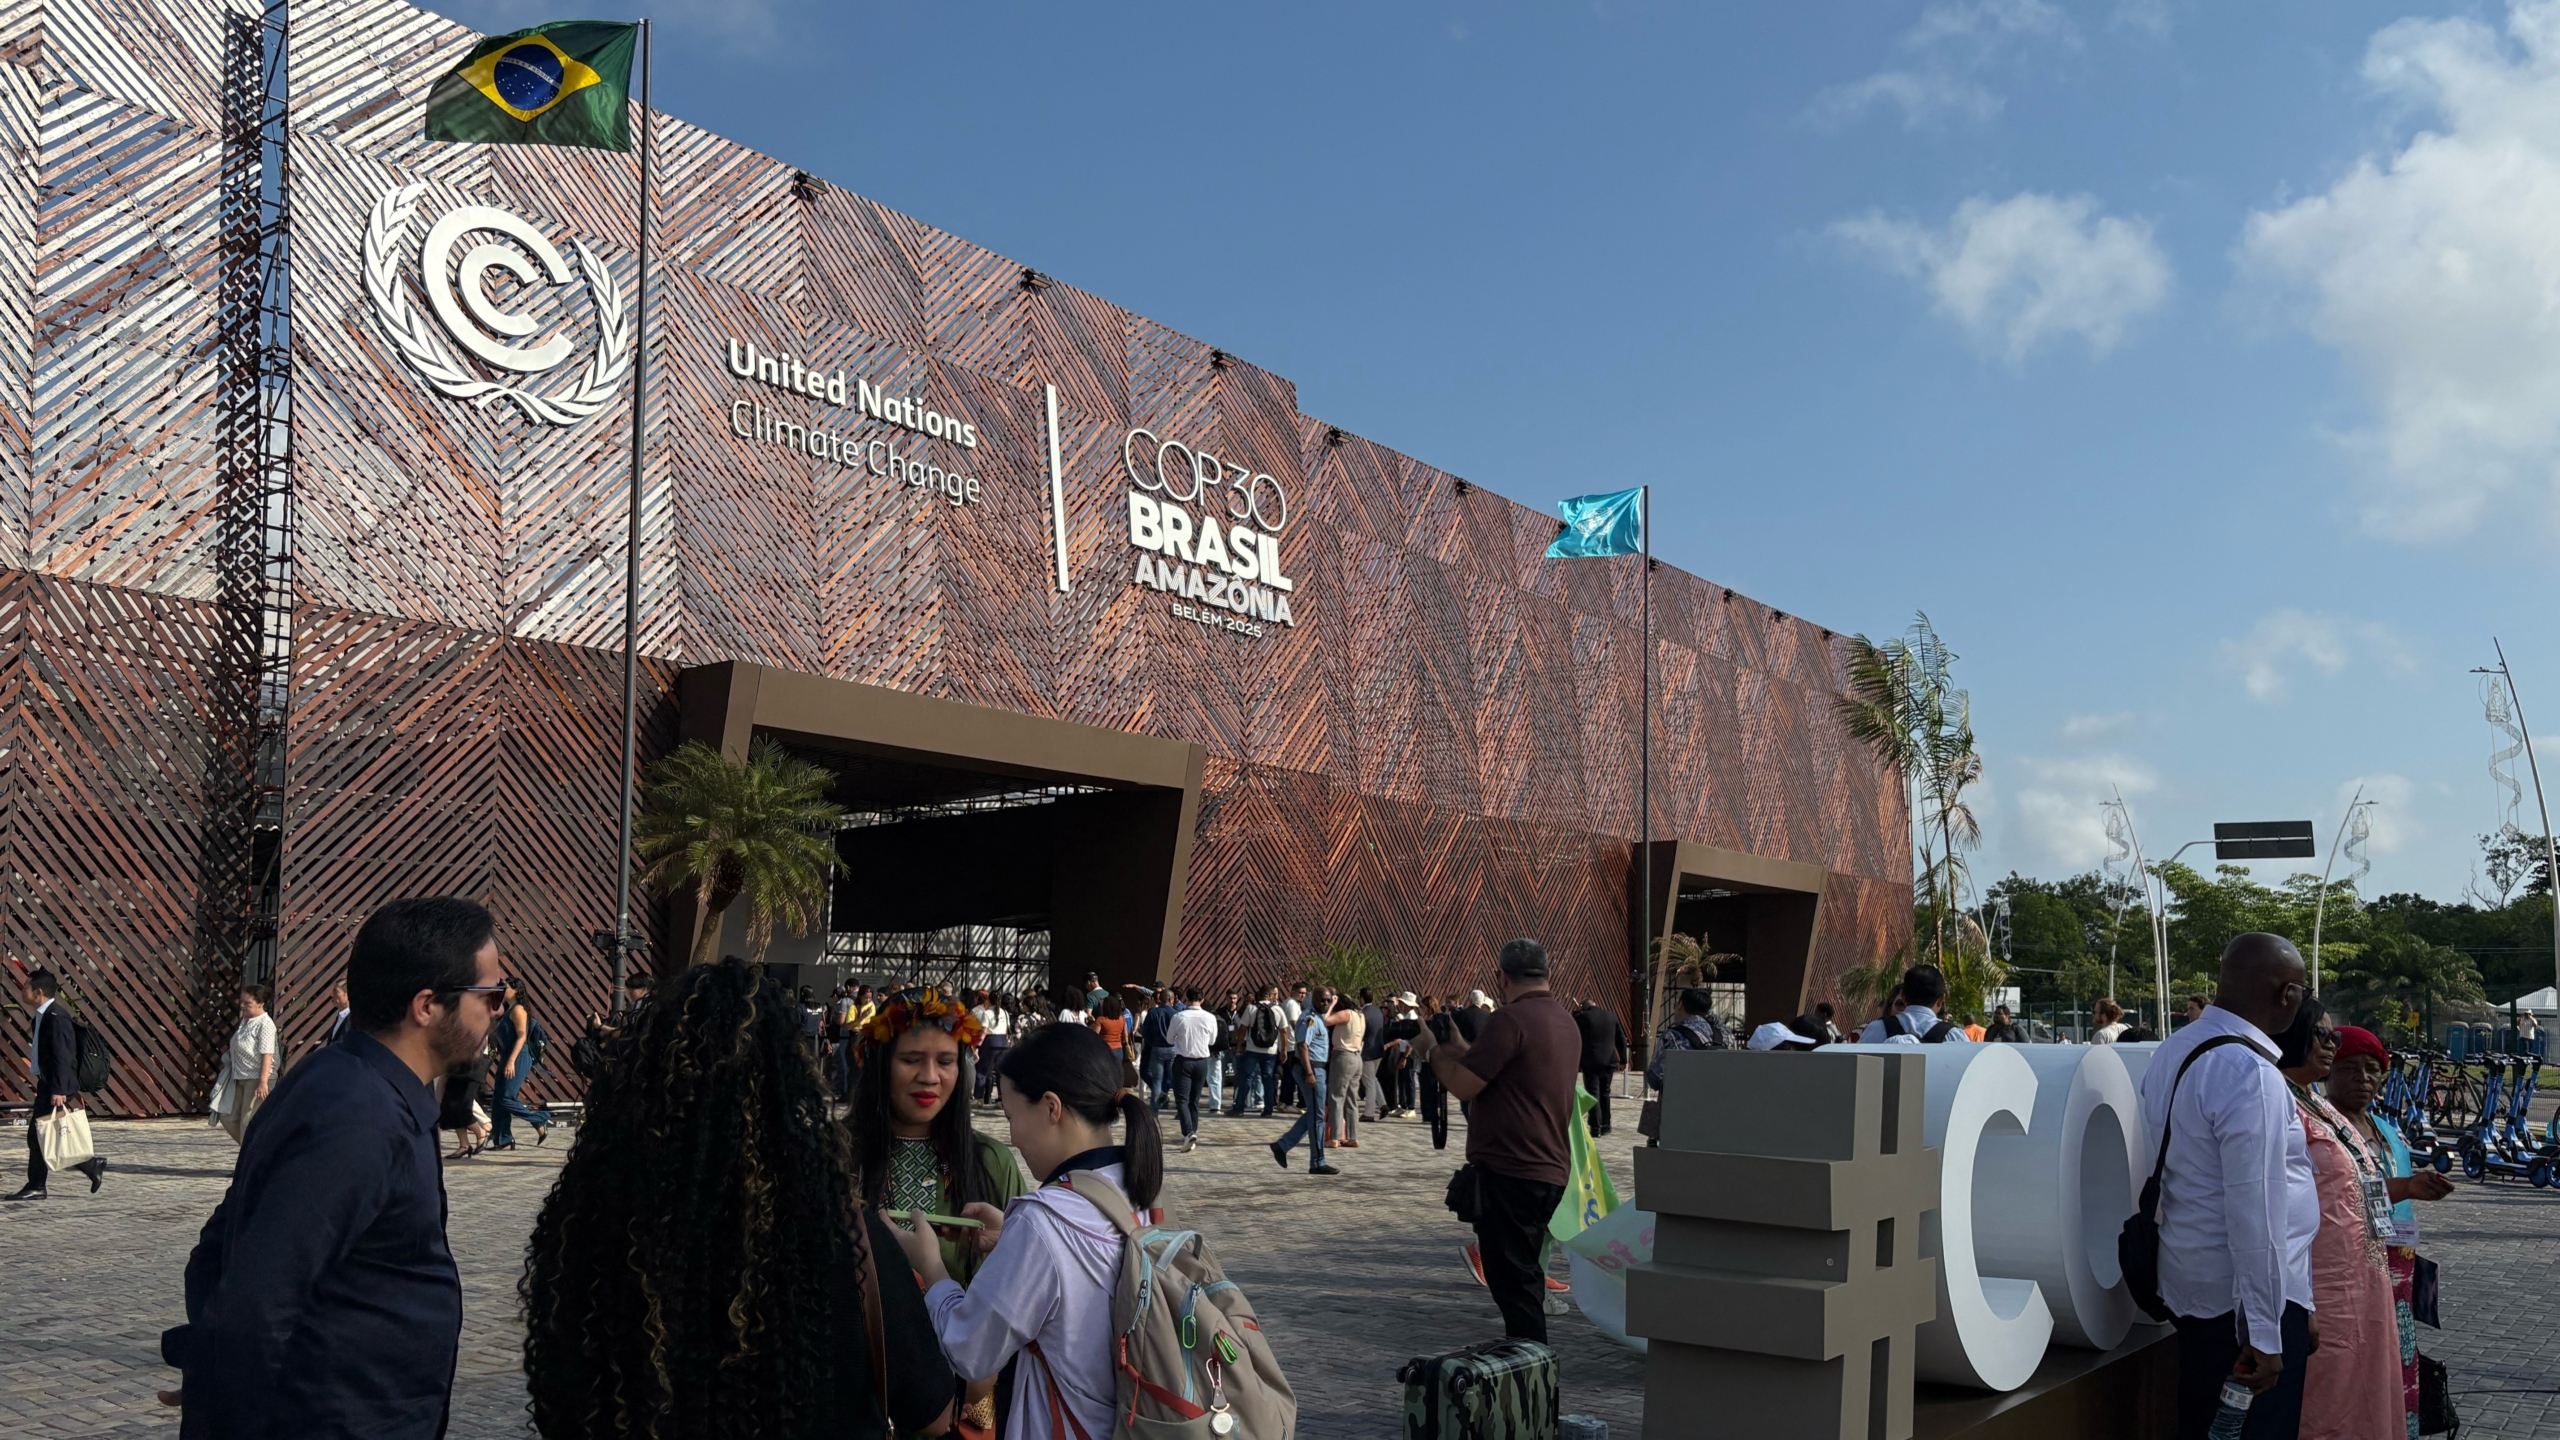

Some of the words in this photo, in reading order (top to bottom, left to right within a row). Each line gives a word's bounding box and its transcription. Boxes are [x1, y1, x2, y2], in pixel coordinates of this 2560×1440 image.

[729, 338, 845, 406] United
[858, 380, 977, 448] Nations
[732, 400, 859, 467] Climate
[867, 441, 981, 505] Change
[1125, 428, 1287, 532] COP30
[1129, 491, 1293, 592] BRASIL
[1134, 554, 1294, 627] AMAZÔNIA
[1172, 602, 1222, 627] BELÉM
[1226, 617, 1263, 639] 2025
